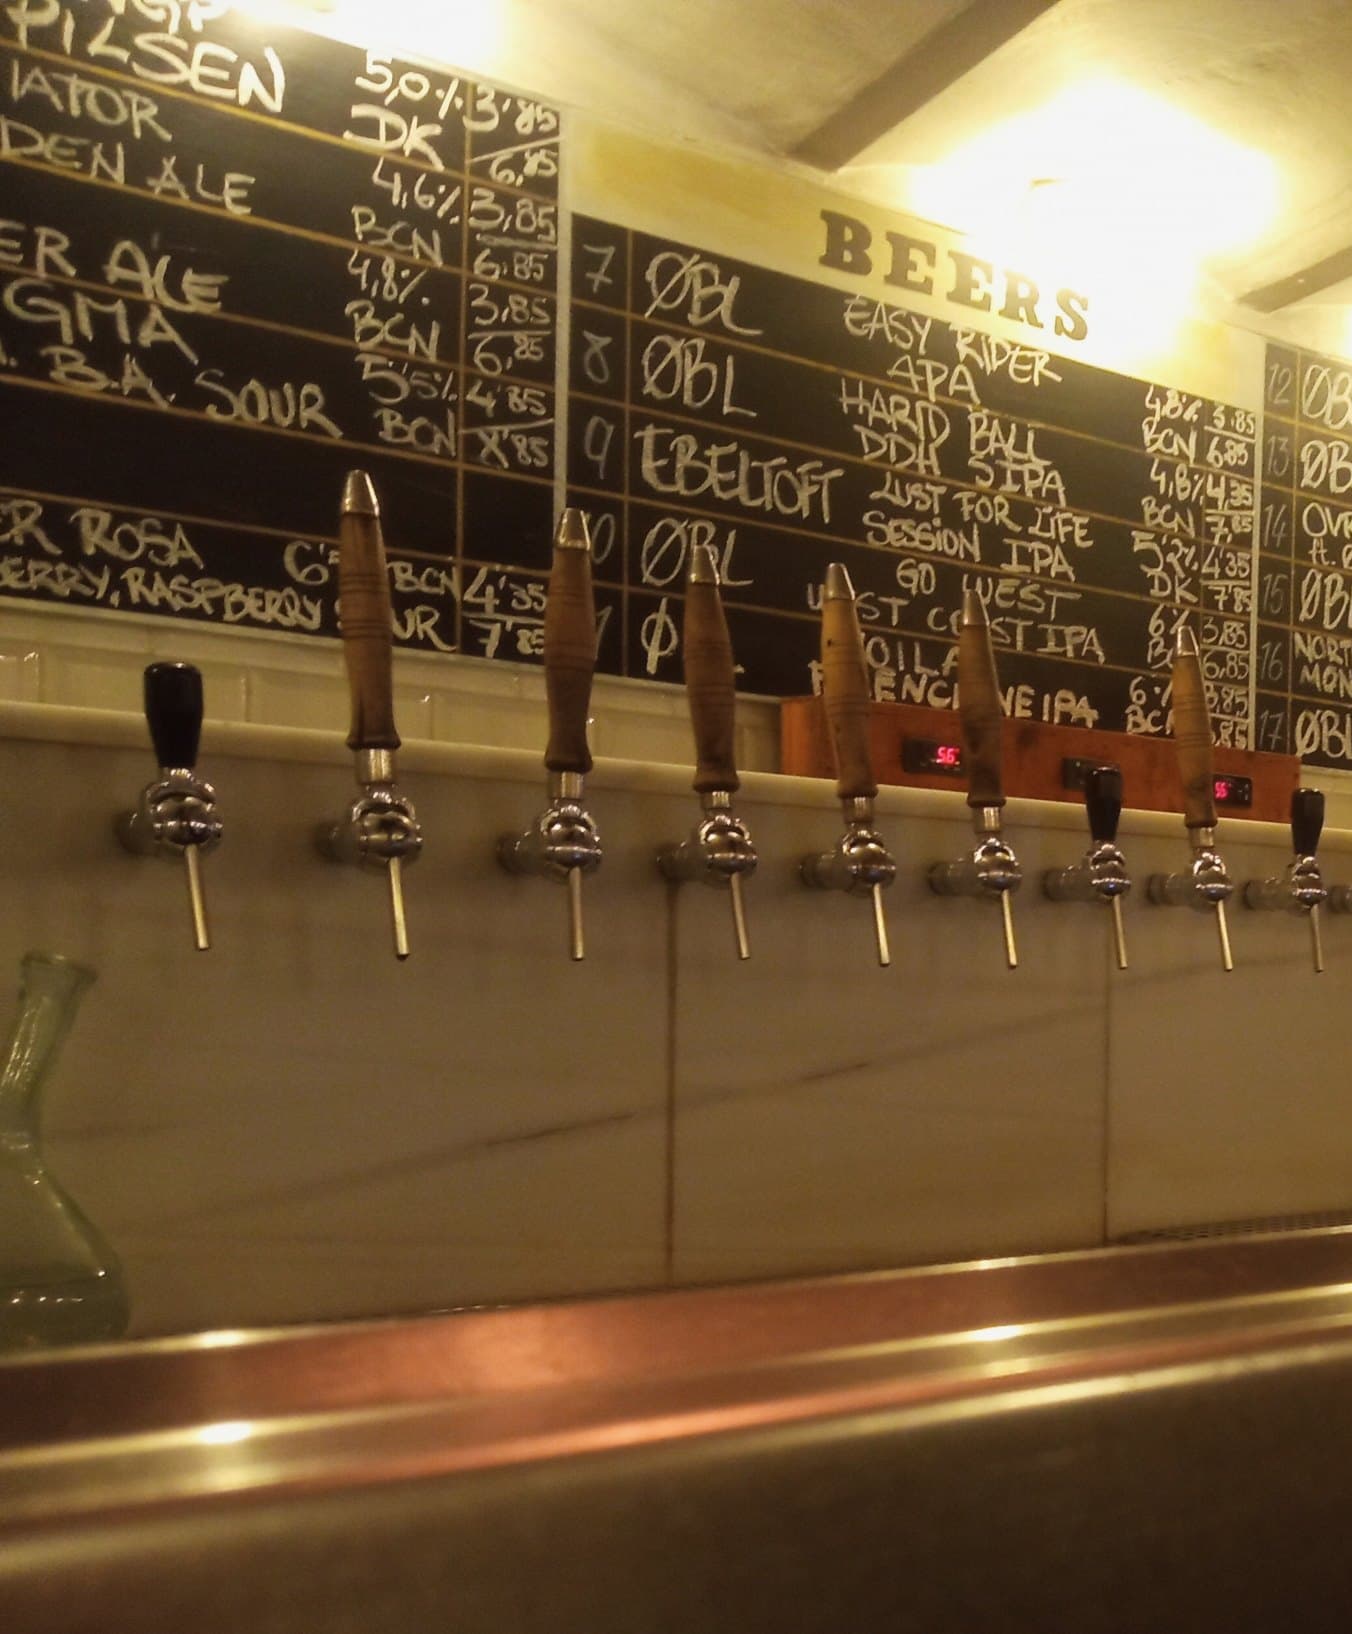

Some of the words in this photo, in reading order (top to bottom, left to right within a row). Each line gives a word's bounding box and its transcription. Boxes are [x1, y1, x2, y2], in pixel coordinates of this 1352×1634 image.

[5, 0, 287, 113] PILSEN
[343, 103, 445, 172] DK
[147, 154, 256, 214] ALE
[583, 243, 616, 294] 7
[818, 208, 1089, 342] BEERS
[344, 299, 441, 363] BCN
[842, 293, 932, 356] EASY
[949, 321, 1064, 387] RIDER
[194, 368, 345, 440] SOUR
[887, 354, 980, 405] APA
[839, 376, 951, 448] HARD
[967, 403, 1053, 466] BALL
[633, 424, 846, 525] EBELTOFT
[68, 507, 204, 571] ROSA
[862, 510, 982, 563] SESSION
[1000, 537, 1076, 582] IPA
[952, 489, 1023, 534] FOR
[1028, 505, 1095, 549] LIFE
[1140, 495, 1196, 539] BCN
[896, 557, 936, 597] GO
[1146, 571, 1199, 605] DK
[1037, 623, 1106, 665] IPA
[1042, 688, 1099, 730] IPA
